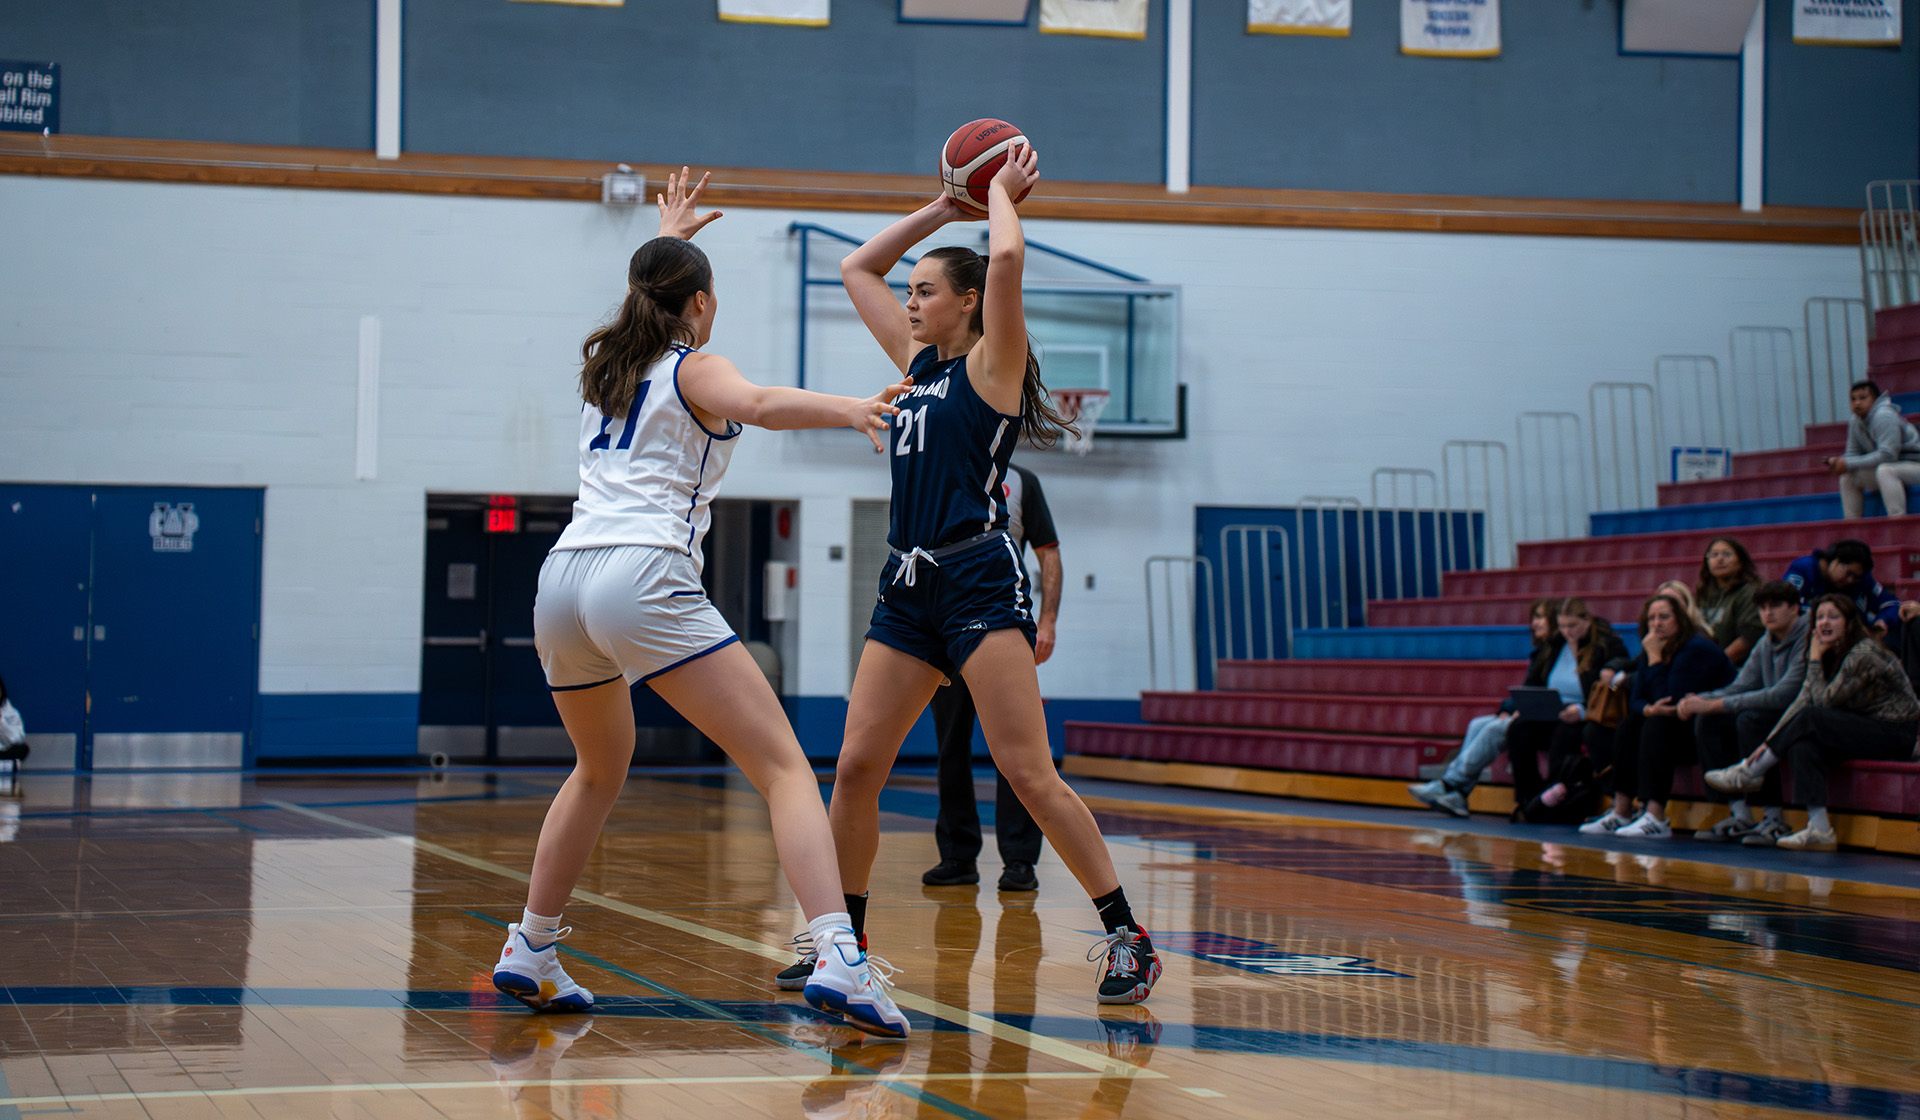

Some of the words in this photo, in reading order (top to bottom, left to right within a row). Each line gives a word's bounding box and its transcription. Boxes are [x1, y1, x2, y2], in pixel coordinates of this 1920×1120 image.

[3, 71, 24, 87] on
[27, 70, 53, 89] the
[21, 88, 52, 107] Rim
[896, 404, 928, 457] 21
